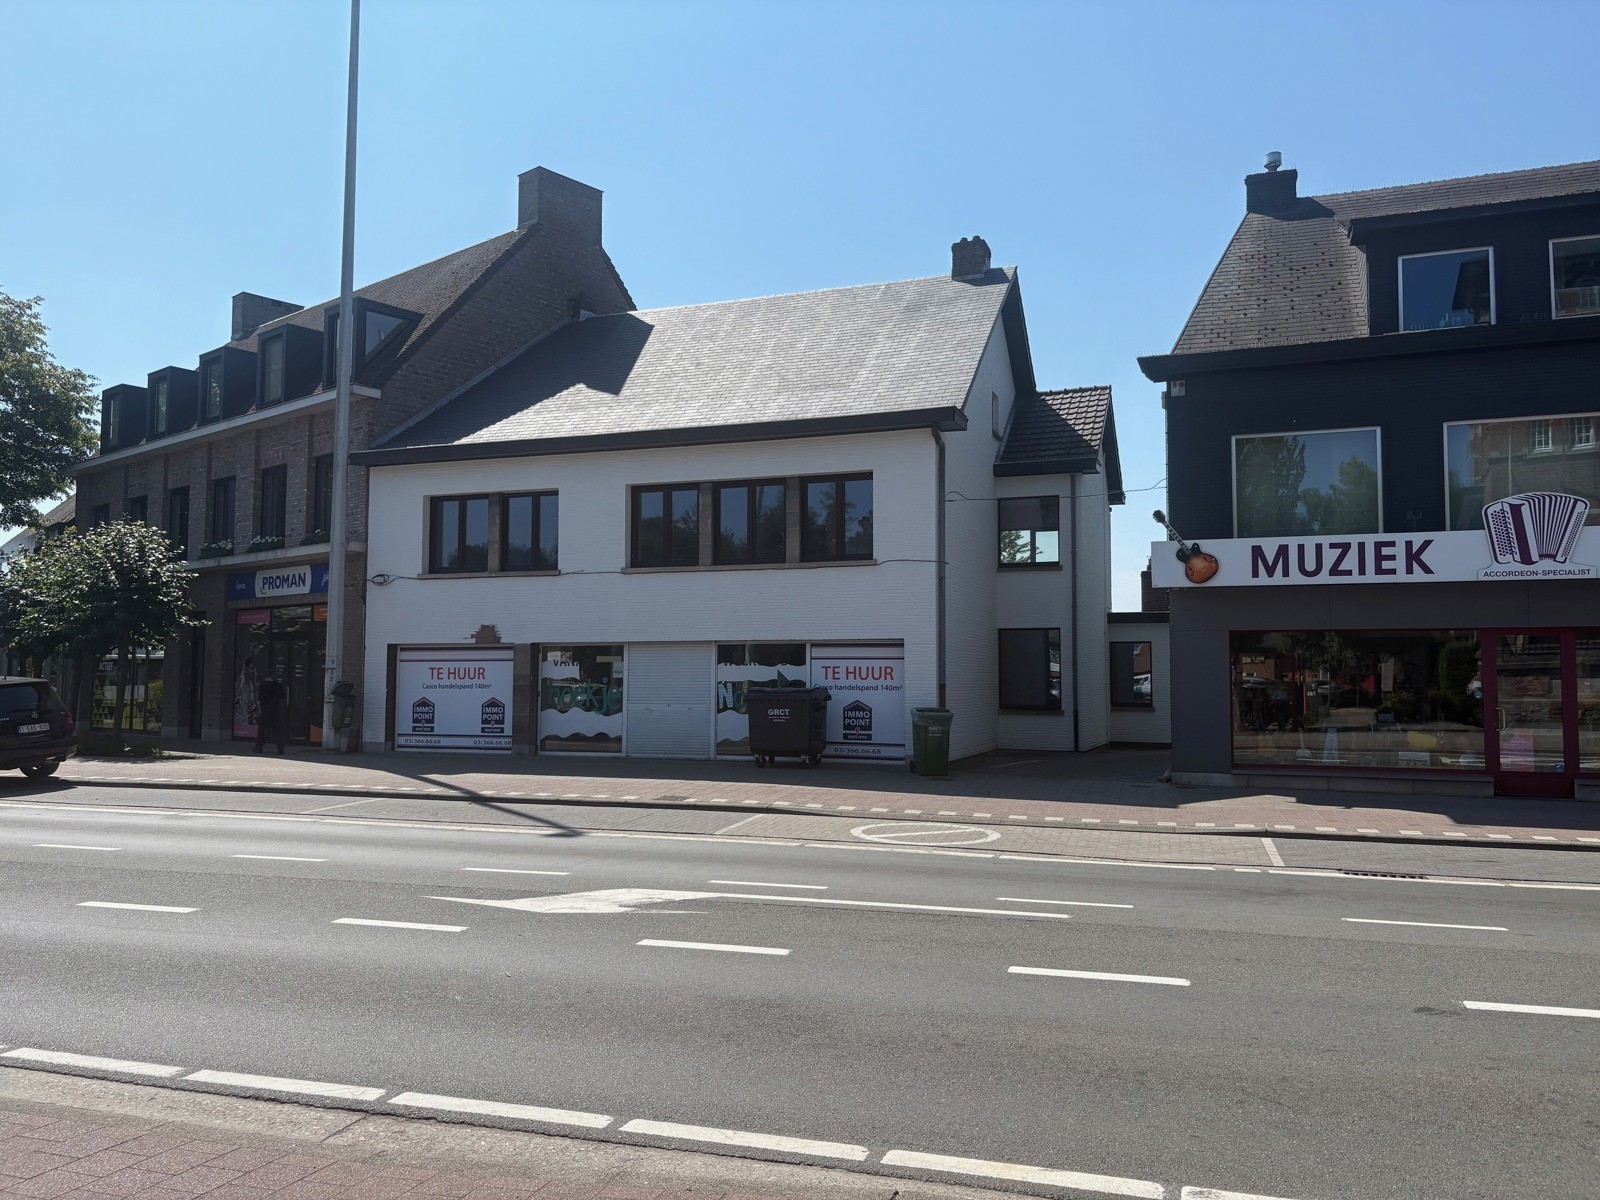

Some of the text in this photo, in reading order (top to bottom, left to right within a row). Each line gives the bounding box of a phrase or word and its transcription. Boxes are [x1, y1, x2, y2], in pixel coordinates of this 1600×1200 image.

[1251, 539, 1435, 579] MUZIEK
[1483, 568, 1591, 577] ACCORDEON-SPECIALIST
[262, 572, 306, 591] PROMAN
[428, 667, 486, 680] TE HUUR
[821, 665, 894, 681] TE HUUR
[834, 684, 879, 692] handelspand
[482, 706, 504, 714] IMMO
[767, 708, 790, 716] GRCT
[844, 710, 871, 718] IMMO
[844, 718, 871, 726] POINT
